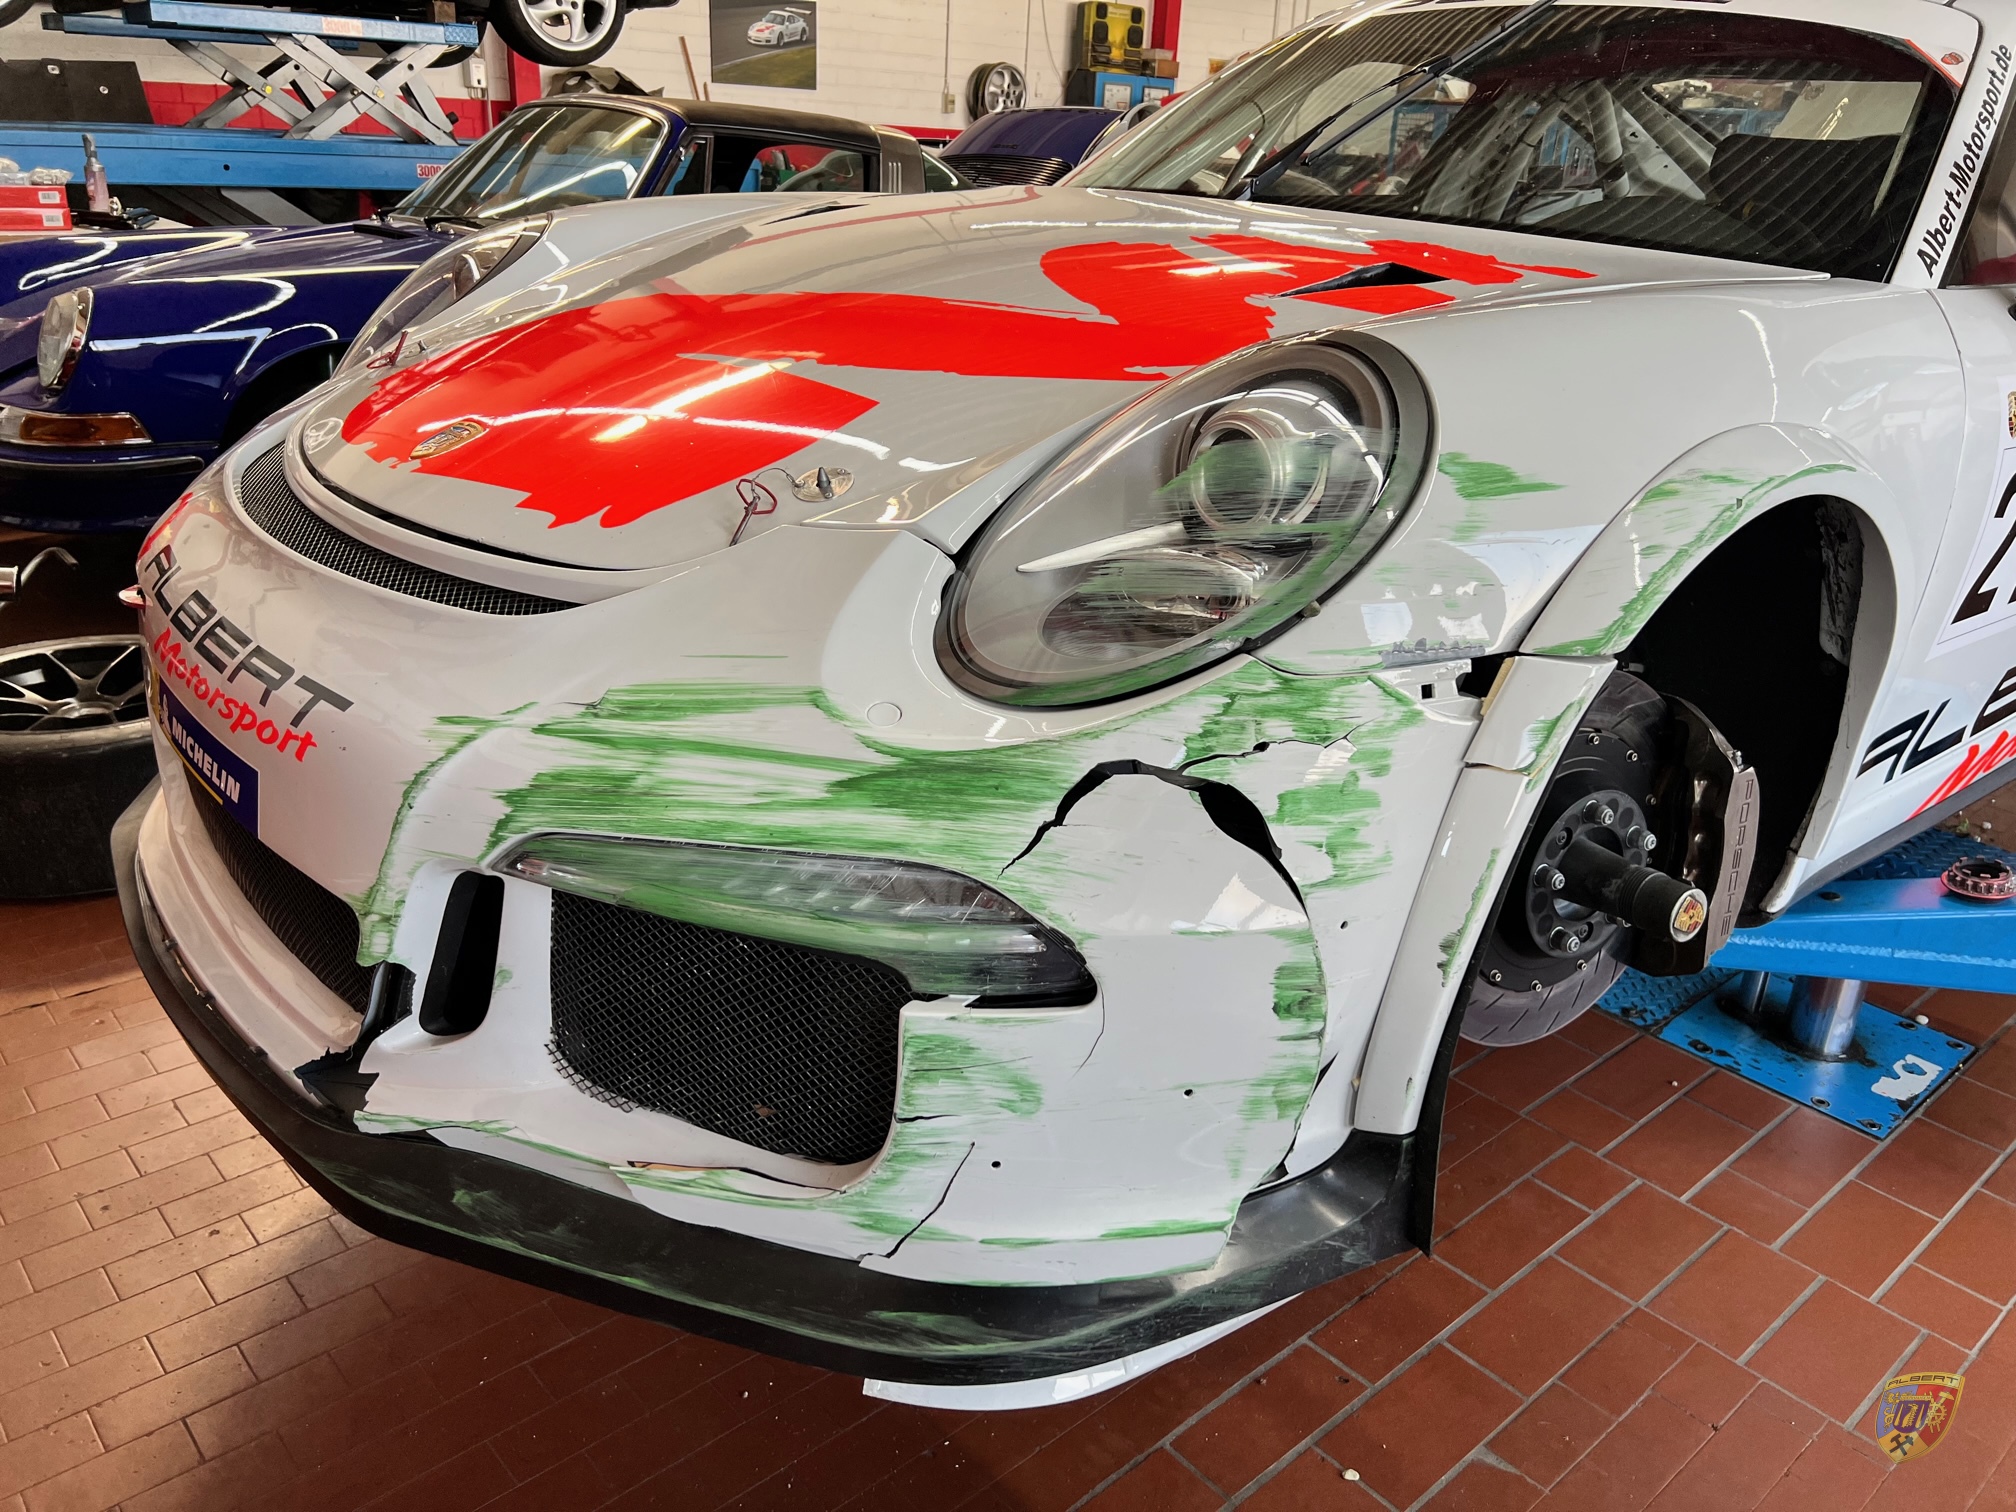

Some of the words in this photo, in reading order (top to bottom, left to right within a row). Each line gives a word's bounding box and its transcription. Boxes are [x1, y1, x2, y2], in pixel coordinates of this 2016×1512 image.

[1916, 44, 2012, 279] Albert-Motorsport.de
[1951, 472, 2016, 625] 2
[145, 544, 354, 728] ALBERT
[154, 627, 317, 762] Motorsport
[173, 720, 240, 804] MICHELIN
[1720, 779, 1754, 937] PORSCHE
